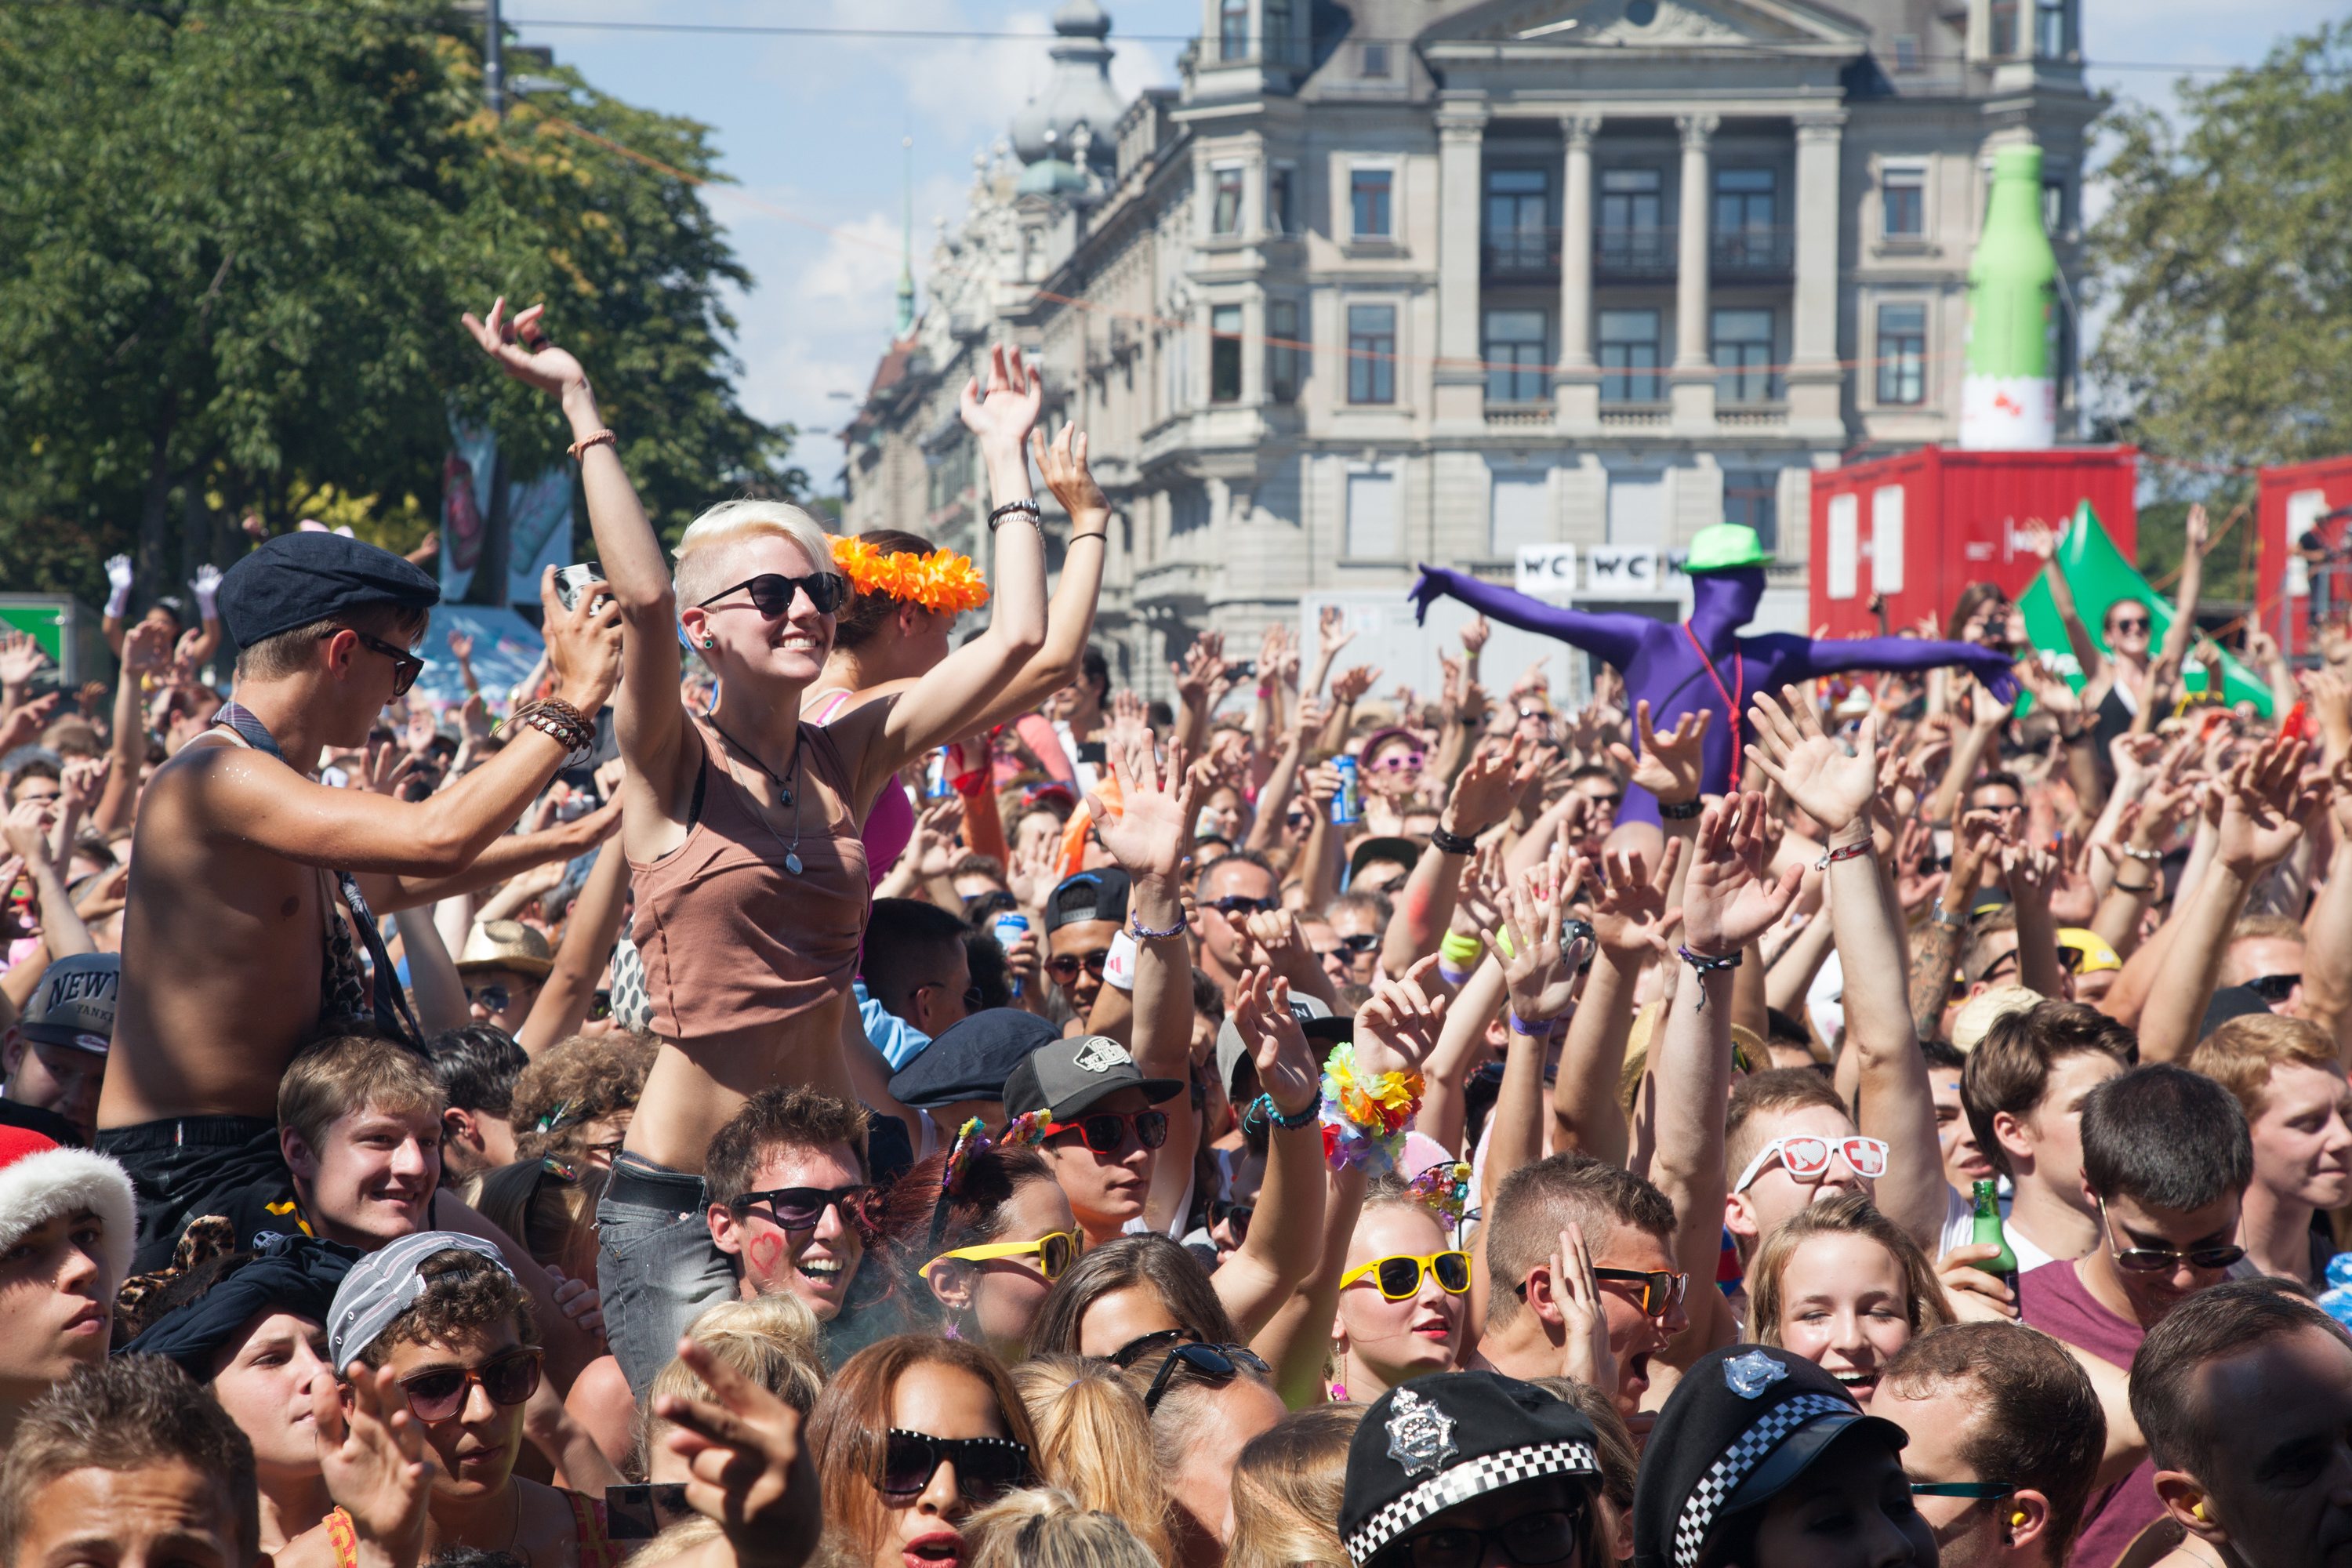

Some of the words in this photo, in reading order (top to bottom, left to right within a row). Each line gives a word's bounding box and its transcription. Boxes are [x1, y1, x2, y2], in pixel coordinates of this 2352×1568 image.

[1524, 556, 1568, 576] WC
[1595, 556, 1647, 578] WC
[46, 971, 111, 1014] NEW
[77, 1004, 115, 1022] YANKE
